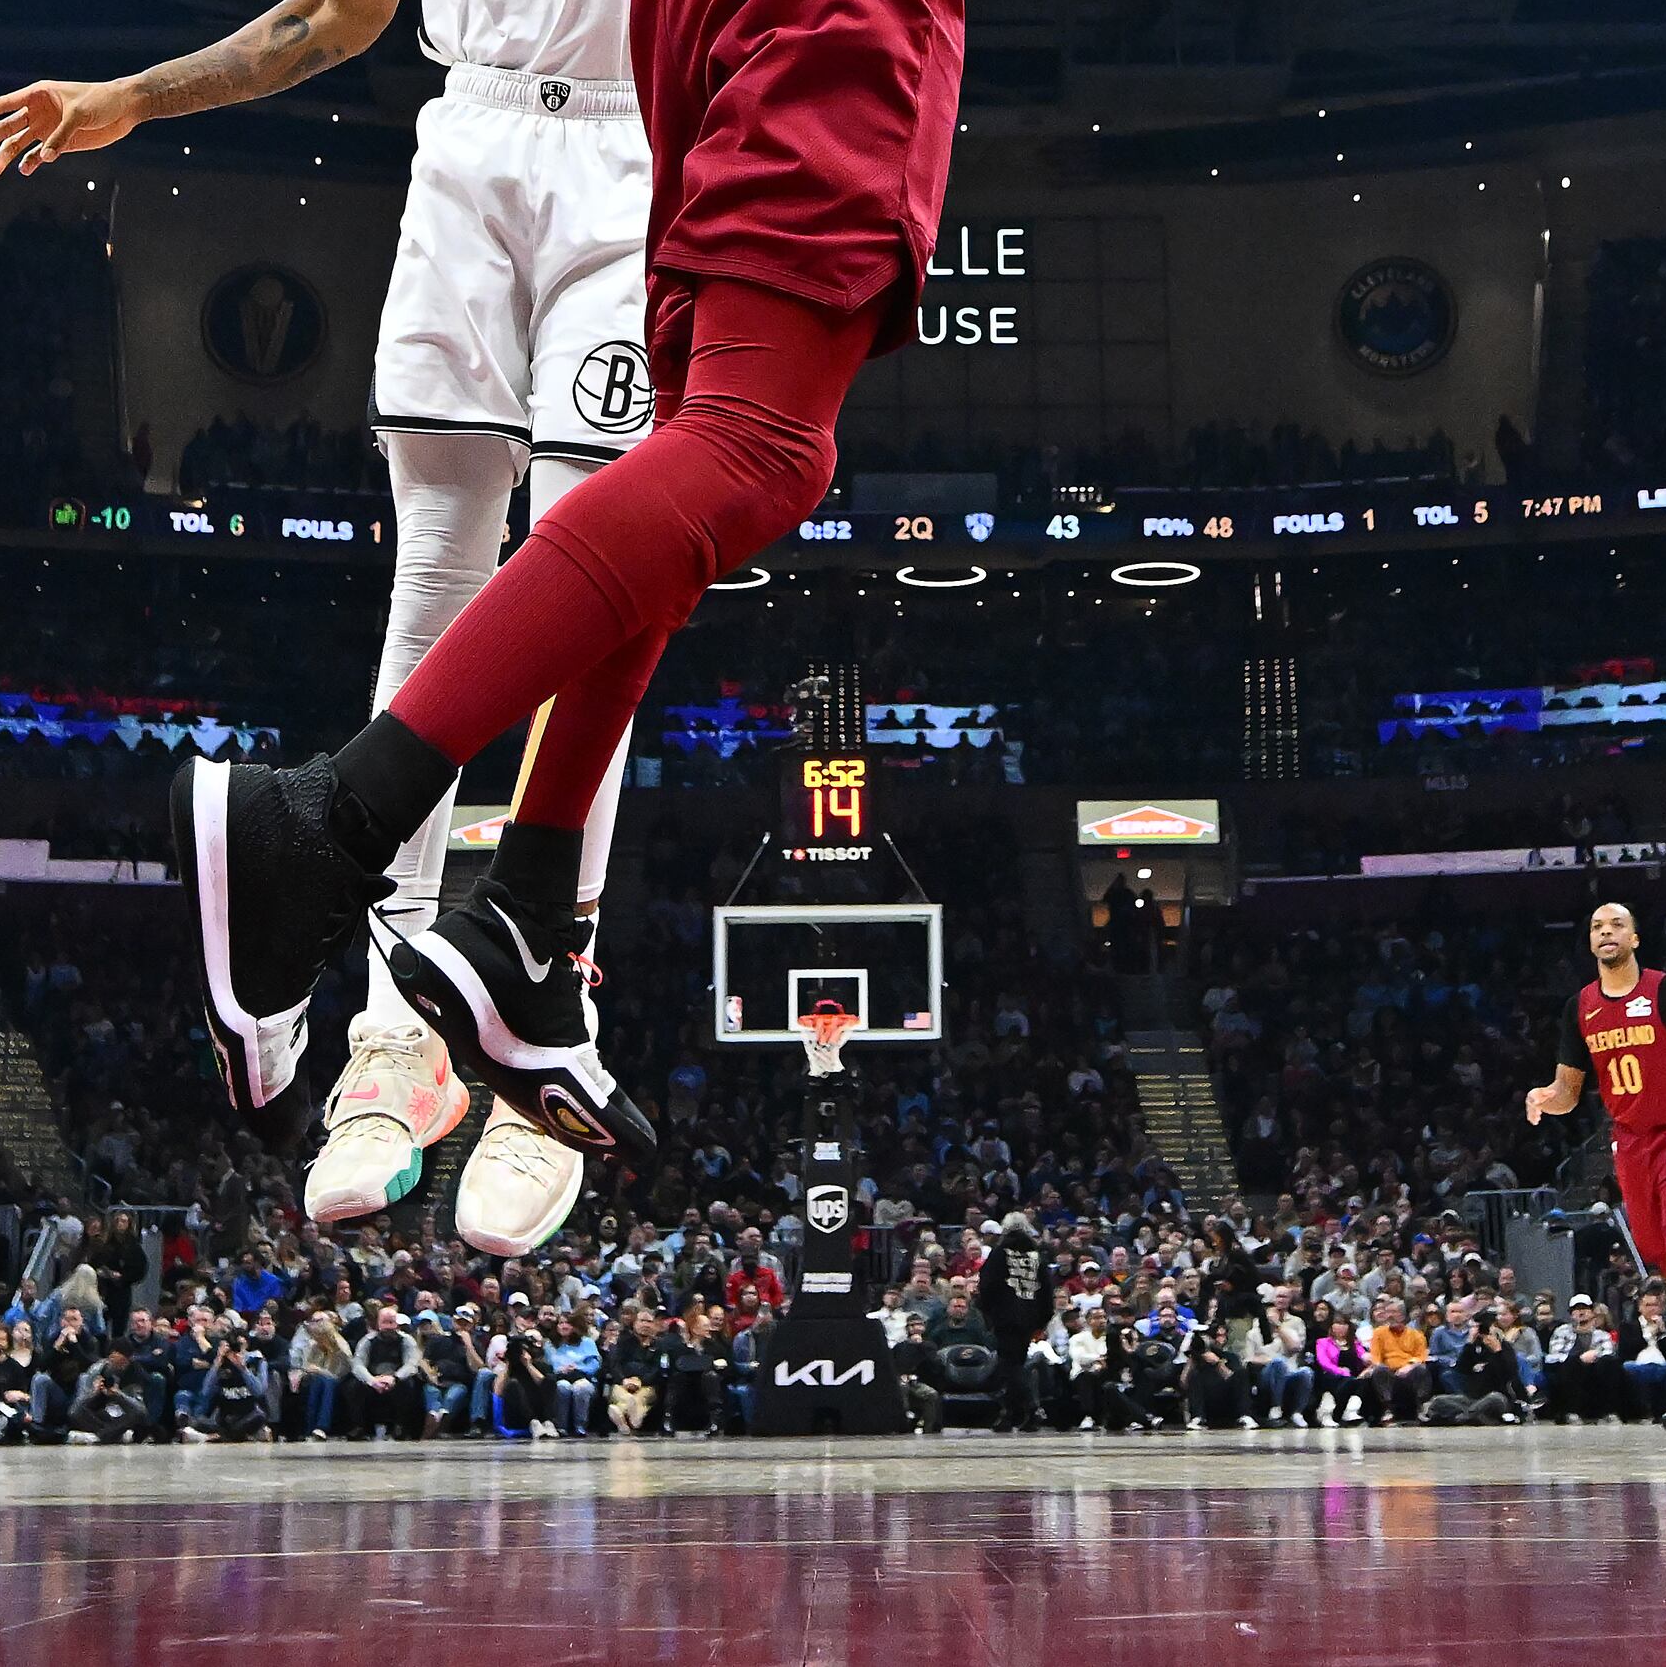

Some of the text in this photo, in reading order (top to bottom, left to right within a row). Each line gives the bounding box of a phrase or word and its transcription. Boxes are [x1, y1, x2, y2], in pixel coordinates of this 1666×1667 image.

[90, 506, 132, 531] -10
[1413, 500, 1489, 526] TOL 5
[1522, 494, 1602, 519] 7:47 PM
[169, 511, 246, 536] TOL 6
[282, 517, 382, 544] FOULS 1
[799, 520, 853, 540] 6:52
[894, 516, 934, 540] 2Q
[1046, 515, 1080, 540] 43
[1143, 516, 1234, 538] FG% 48
[1273, 509, 1376, 534] FOULS 1
[803, 760, 866, 788] 6:52
[813, 788, 861, 837] 14
[807, 847, 872, 861] TISSOT
[1607, 1054, 1643, 1095] 10
[811, 1200, 846, 1226] ups
